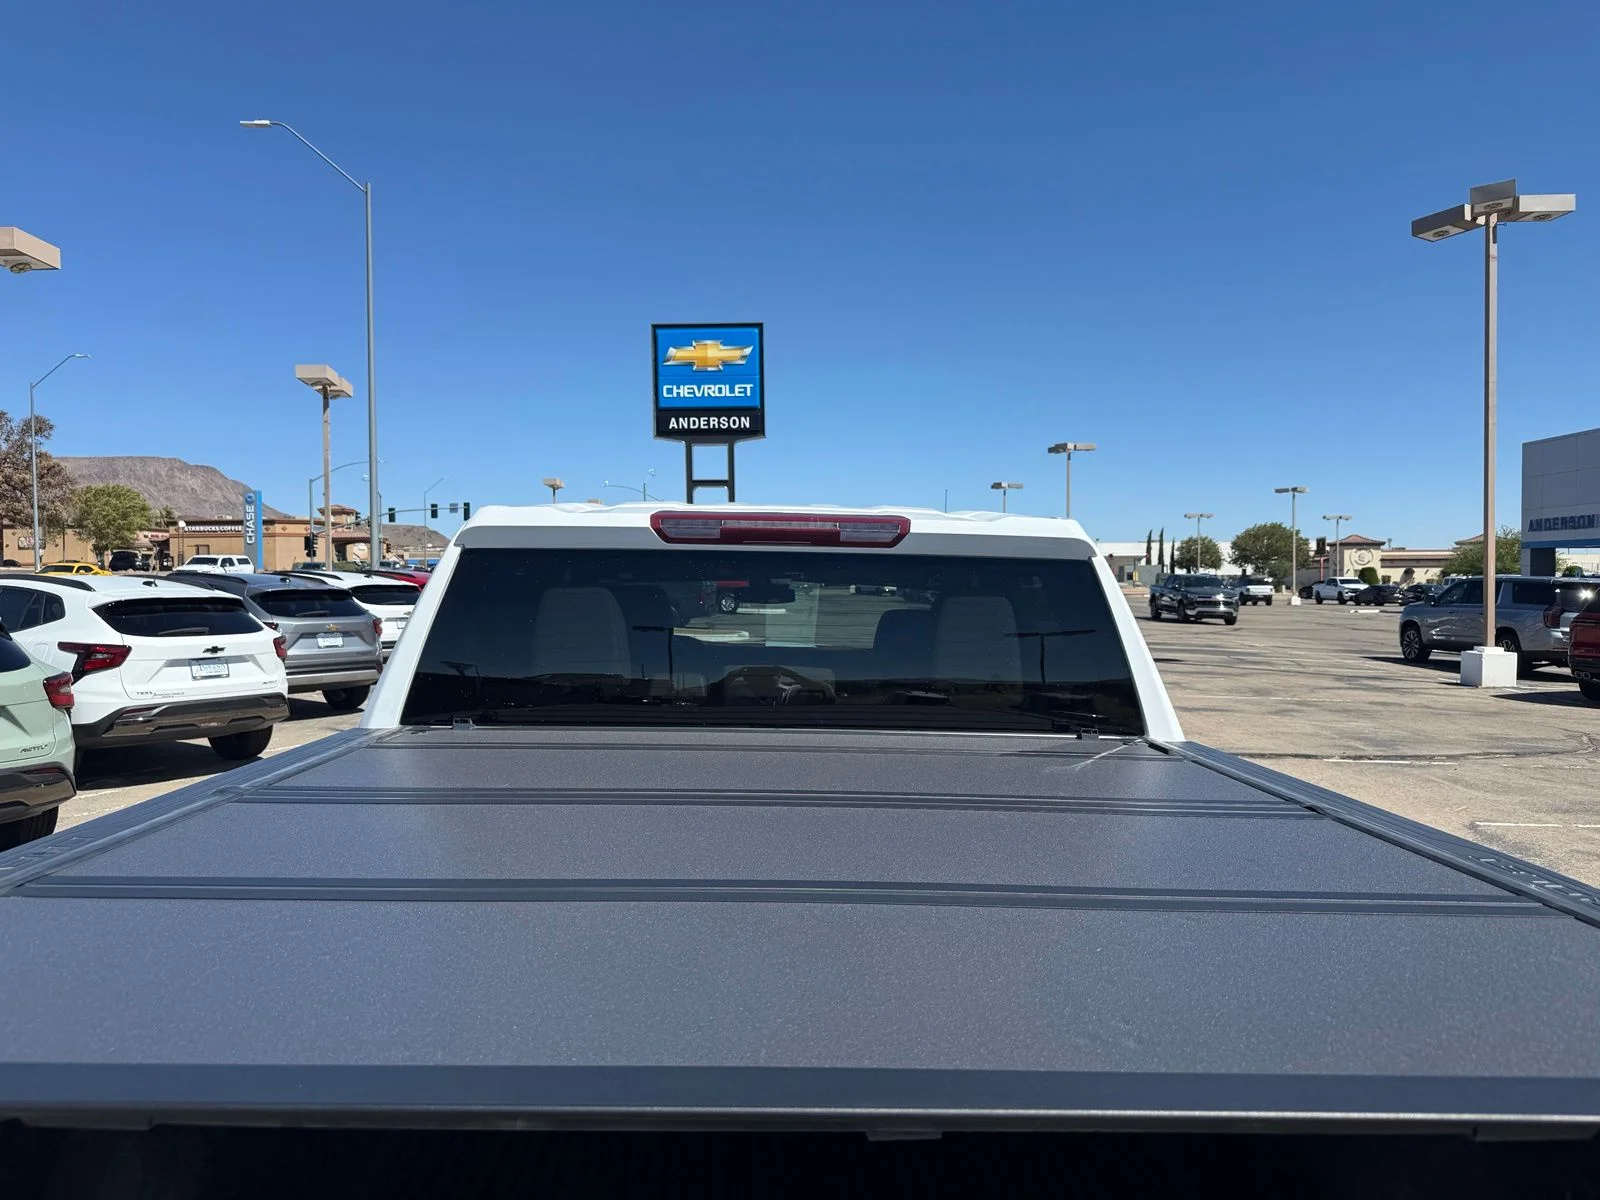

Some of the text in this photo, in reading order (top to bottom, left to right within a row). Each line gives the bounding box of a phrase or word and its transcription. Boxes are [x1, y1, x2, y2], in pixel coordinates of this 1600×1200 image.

[662, 383, 754, 398] CHEVROLET
[668, 416, 752, 430] ANDERSON
[245, 504, 256, 545] CHASE
[1527, 513, 1596, 532] ANDERSON
